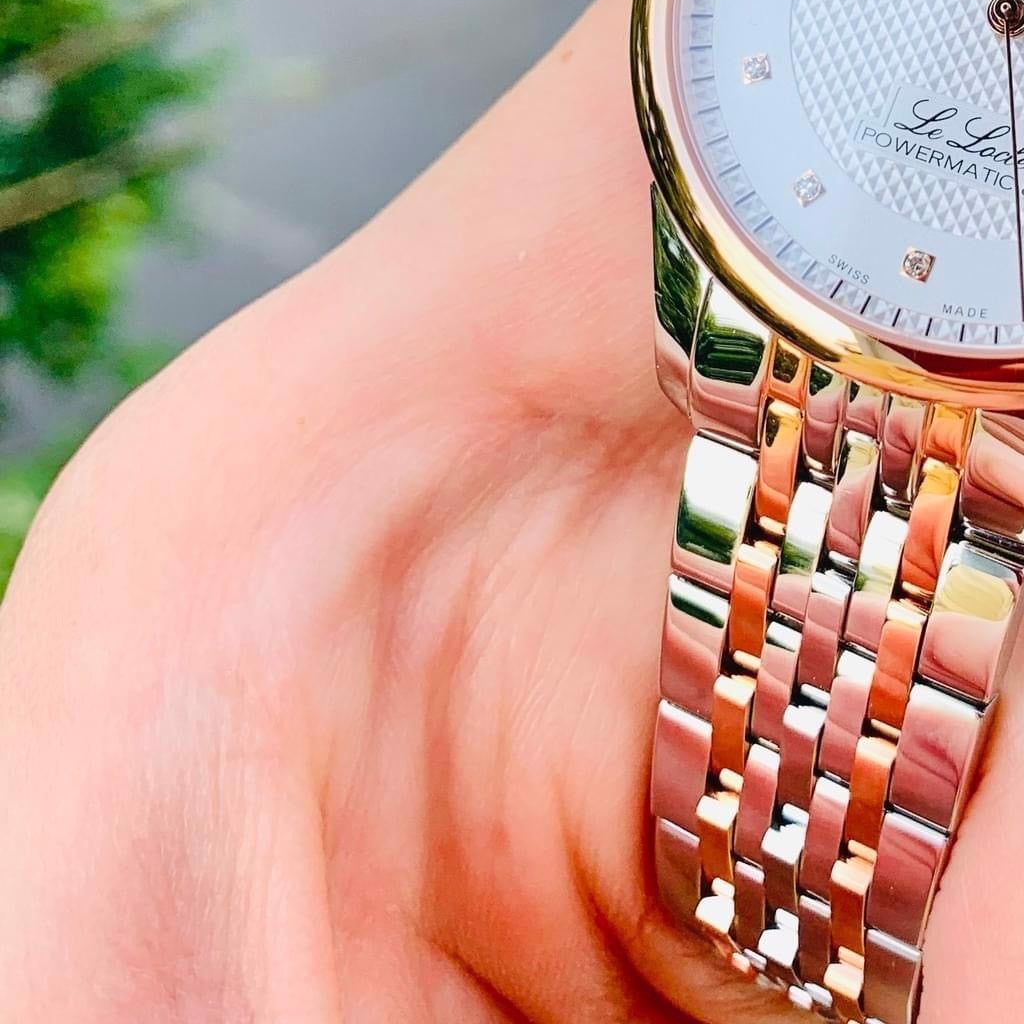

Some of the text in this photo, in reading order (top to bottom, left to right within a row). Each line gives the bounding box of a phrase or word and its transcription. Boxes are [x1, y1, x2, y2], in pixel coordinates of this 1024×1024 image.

[893, 99, 957, 140] Le
[860, 126, 1016, 190] POWERMATIC
[827, 253, 988, 319] SWISS MADE
